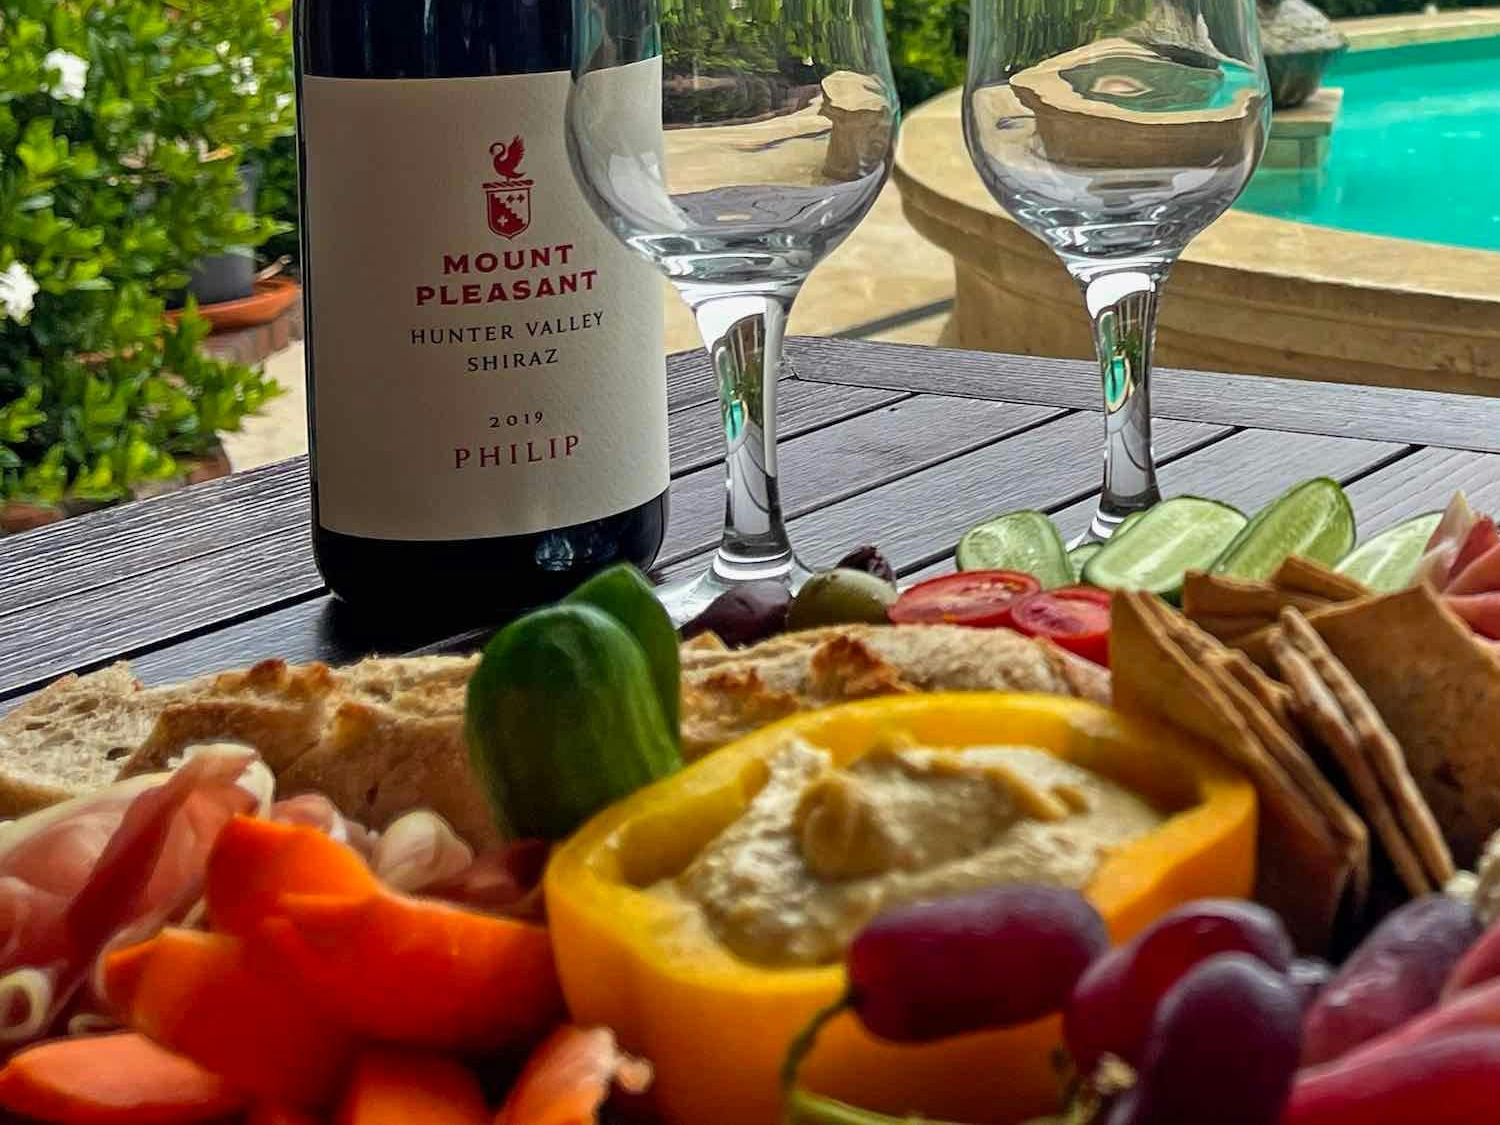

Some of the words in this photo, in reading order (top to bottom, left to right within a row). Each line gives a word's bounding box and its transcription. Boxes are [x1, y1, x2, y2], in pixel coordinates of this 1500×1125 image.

[443, 243, 574, 275] MOUNT
[415, 270, 598, 307] PLEASANT
[410, 324, 515, 345] HUNTER
[525, 310, 605, 338] VALLEY
[467, 348, 559, 373] SHIRAZ
[488, 410, 545, 429] 2019
[454, 434, 580, 469] PHILIP
